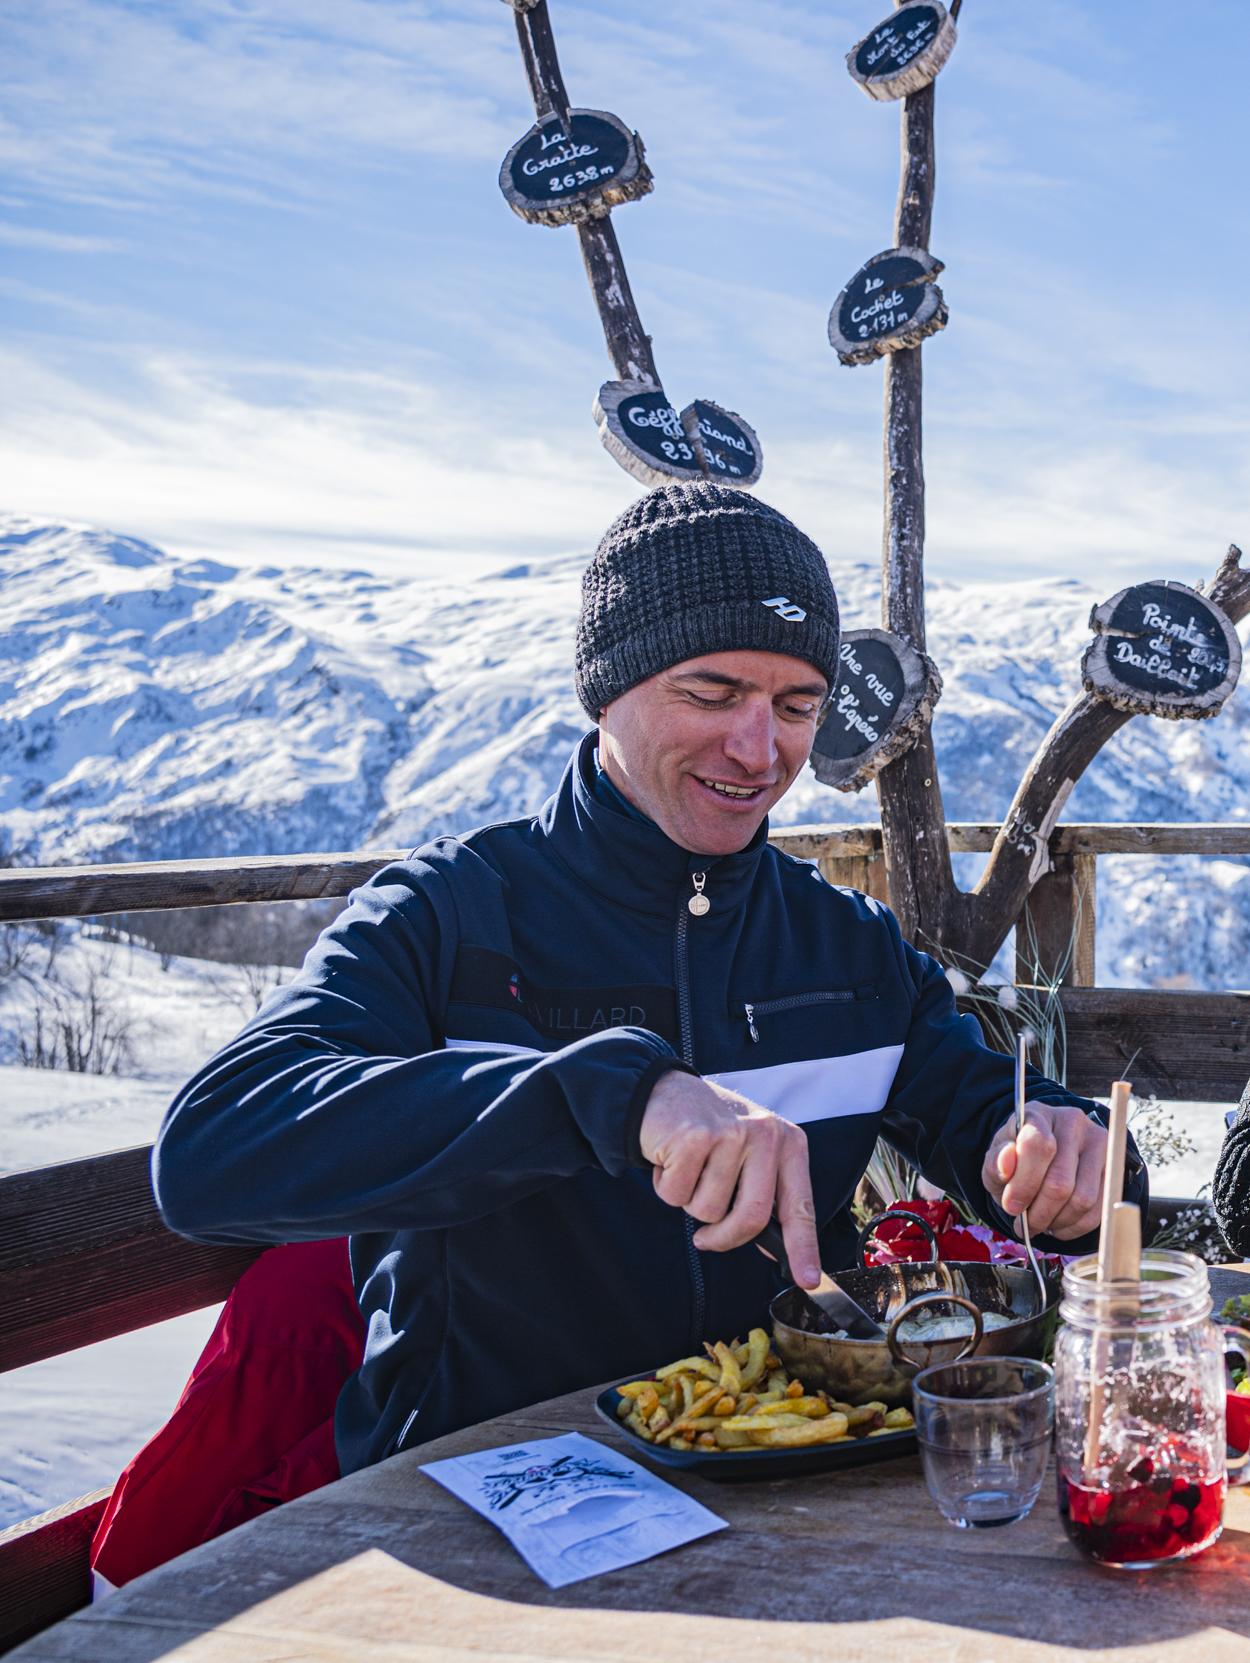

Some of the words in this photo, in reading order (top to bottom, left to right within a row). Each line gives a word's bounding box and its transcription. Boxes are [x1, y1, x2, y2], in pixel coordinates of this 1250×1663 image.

[873, 26, 895, 44] Le
[540, 132, 567, 151] La
[864, 277, 884, 294] Le
[850, 289, 905, 323] Cochet
[839, 643, 863, 676] Une
[864, 672, 895, 707] vue
[836, 693, 879, 742] l'apéro
